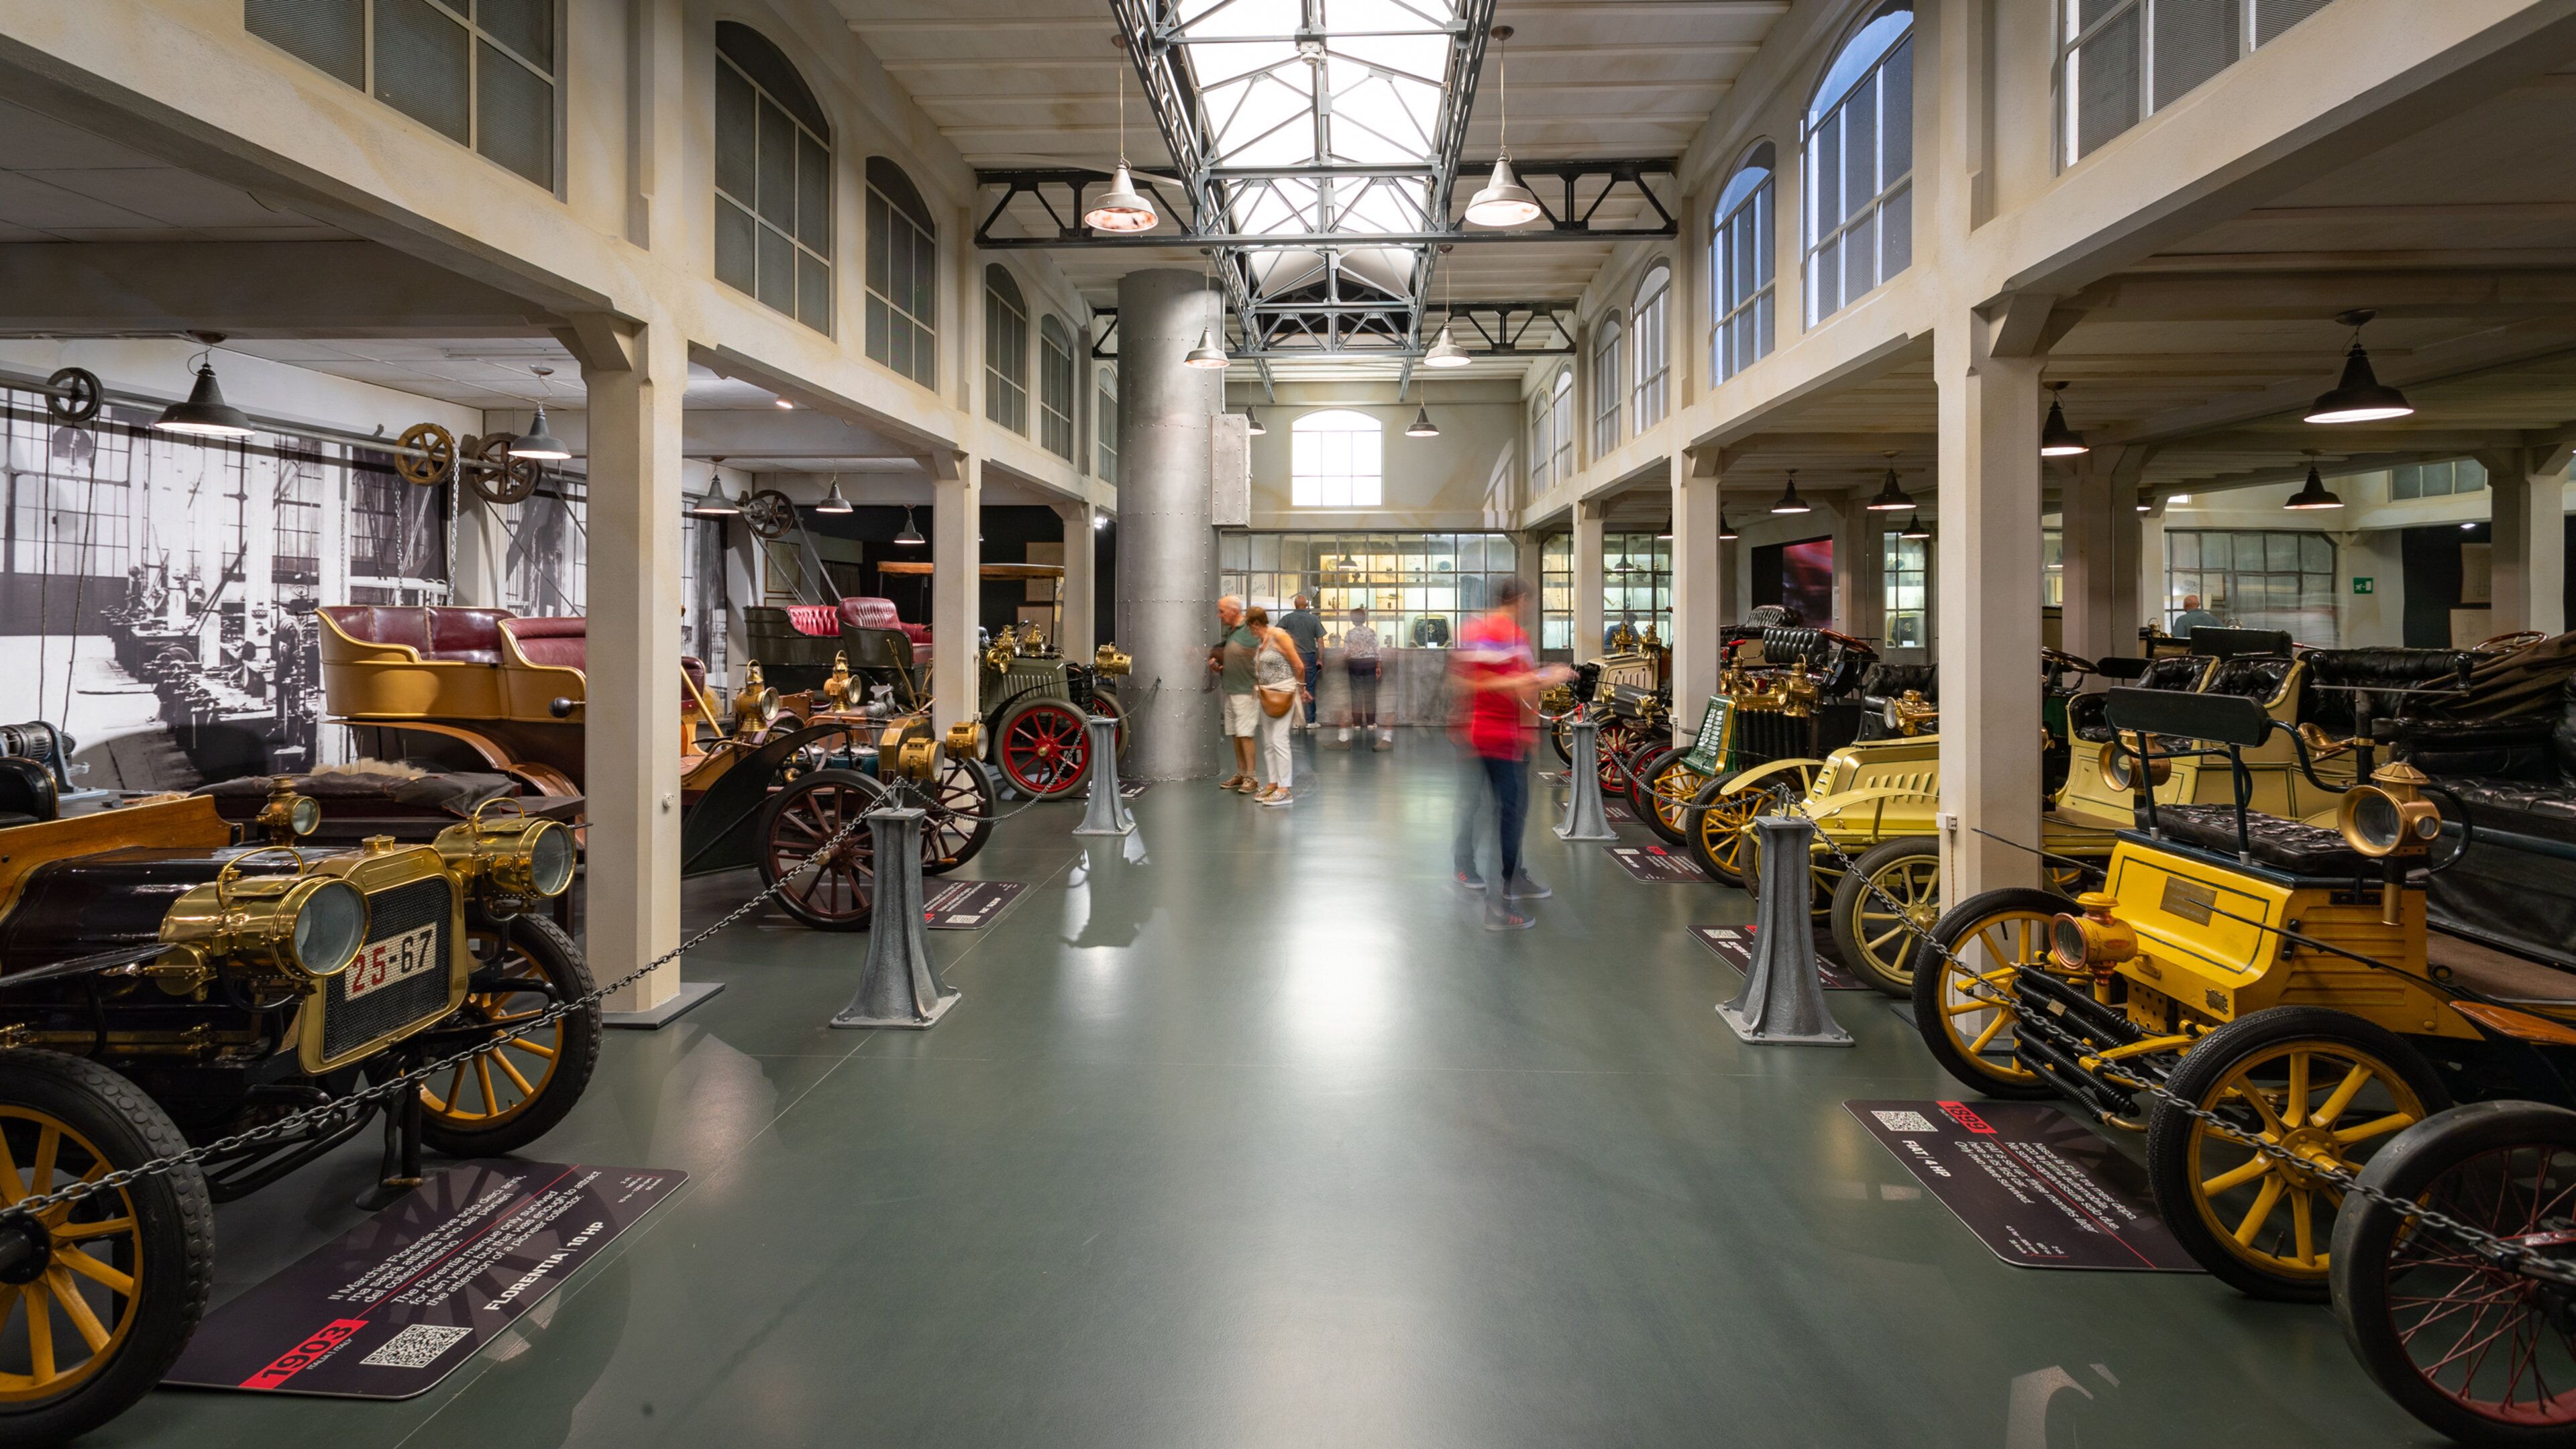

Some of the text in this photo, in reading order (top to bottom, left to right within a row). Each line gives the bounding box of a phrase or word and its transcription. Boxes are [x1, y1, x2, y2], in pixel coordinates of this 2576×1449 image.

[351, 929, 433, 994] 25-67
[1945, 1105, 1988, 1130] 1899
[1902, 1140, 1929, 1156] FIAT
[1929, 1166, 1951, 1177] HP
[1954, 1141, 2035, 1203] Only two have survived.
[1967, 1141, 1986, 1154] here
[1988, 1159, 2002, 1167] its
[1997, 1167, 2017, 1178] first
[1980, 1142, 2004, 1155] FIAT
[2002, 1159, 2020, 1169] set
[2025, 1178, 2049, 1194] three
[2044, 1193, 2079, 1218] months
[2074, 1218, 2099, 1234] later
[2004, 1142, 2120, 1230] Ne sono sopravvissute solo due.
[2019, 1142, 2039, 1155] ecco
[2039, 1161, 2067, 1176] prima
[2062, 1176, 2108, 1210] automobile.
[2032, 1142, 2057, 1159] Nasce
[2079, 1178, 2095, 1187] tre
[2090, 1187, 2118, 1202] mesi
[2111, 1202, 2137, 1220] dopo,
[337, 1263, 392, 1293] Marchio
[386, 1232, 439, 1262] Florentia
[435, 1218, 460, 1232] vive
[457, 1204, 482, 1218] solo
[478, 1189, 504, 1204] dieci
[500, 1175, 527, 1189] anni,
[347, 1193, 514, 1301] ma saprà attirare uno dei pionieri
[390, 1191, 558, 1303] The Florentia marque only survived
[408, 1293, 429, 1305] for
[427, 1279, 450, 1293] ten
[446, 1259, 478, 1279] years
[473, 1246, 497, 1259] but
[492, 1232, 517, 1246] that
[512, 1218, 535, 1232] was
[533, 1195, 568, 1219] enough
[574, 1171, 602, 1189] attract
[426, 1292, 449, 1306] the
[447, 1260, 494, 1292] attention
[492, 1250, 505, 1260] of
[510, 1220, 547, 1247] pioneer
[545, 1195, 584, 1221] collector.
[483, 1222, 604, 1310] FLORENTIA 10 HP
[364, 1239, 463, 1303] del collezionismo.
[261, 1326, 353, 1379] 1903
[306, 1338, 353, 1370] ITALIA ITALY
